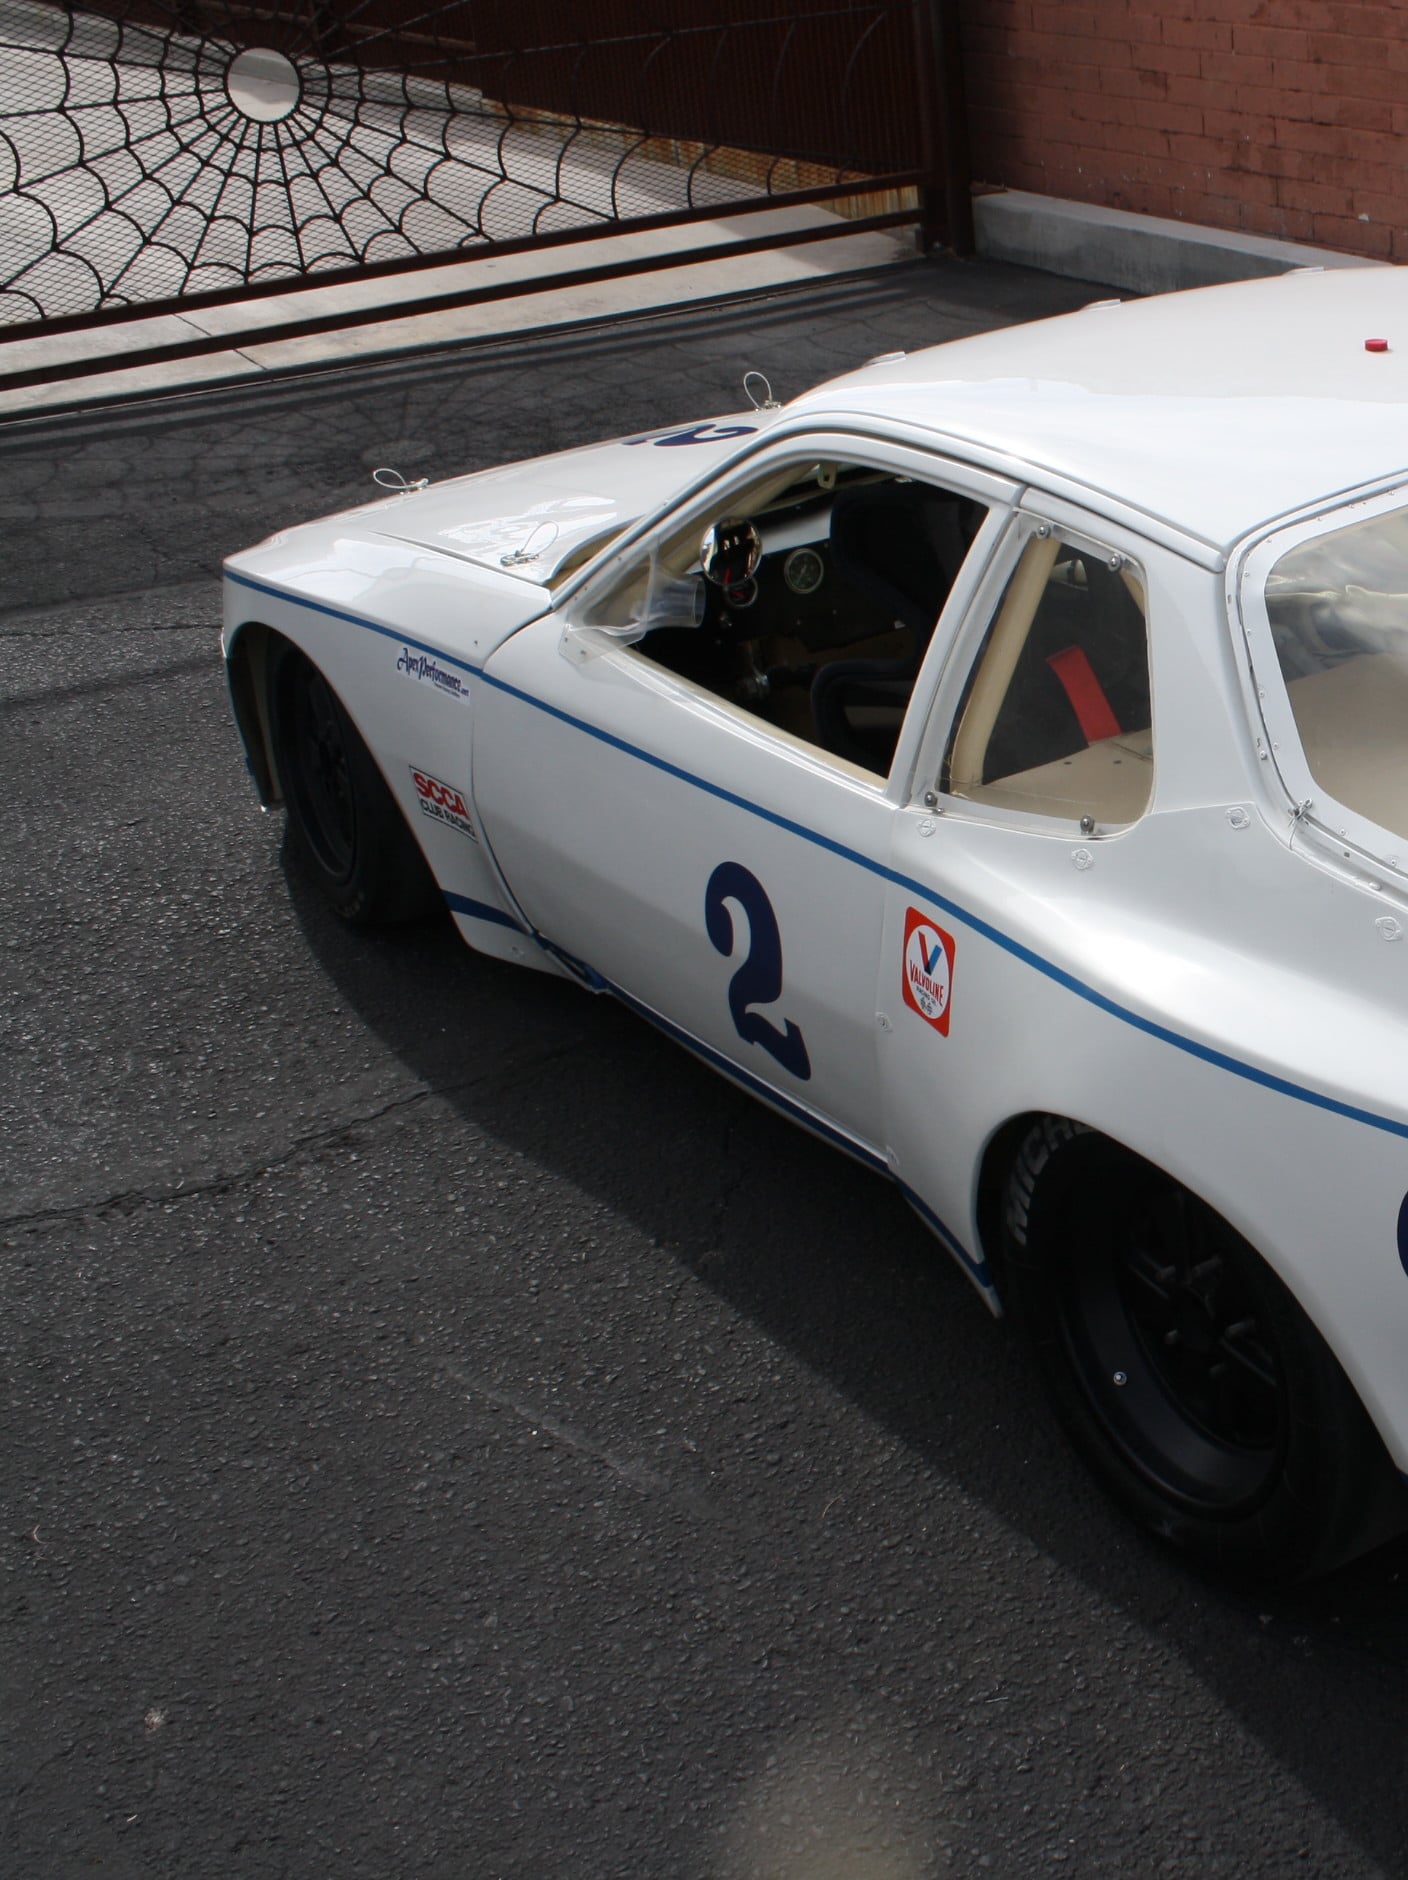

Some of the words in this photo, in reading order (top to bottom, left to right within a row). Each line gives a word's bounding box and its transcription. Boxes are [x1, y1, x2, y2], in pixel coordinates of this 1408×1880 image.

[413, 772, 468, 818] SCCA
[420, 799, 444, 818] CLUB
[705, 861, 811, 1081] 2
[909, 960, 944, 1007] VALVOLINE
